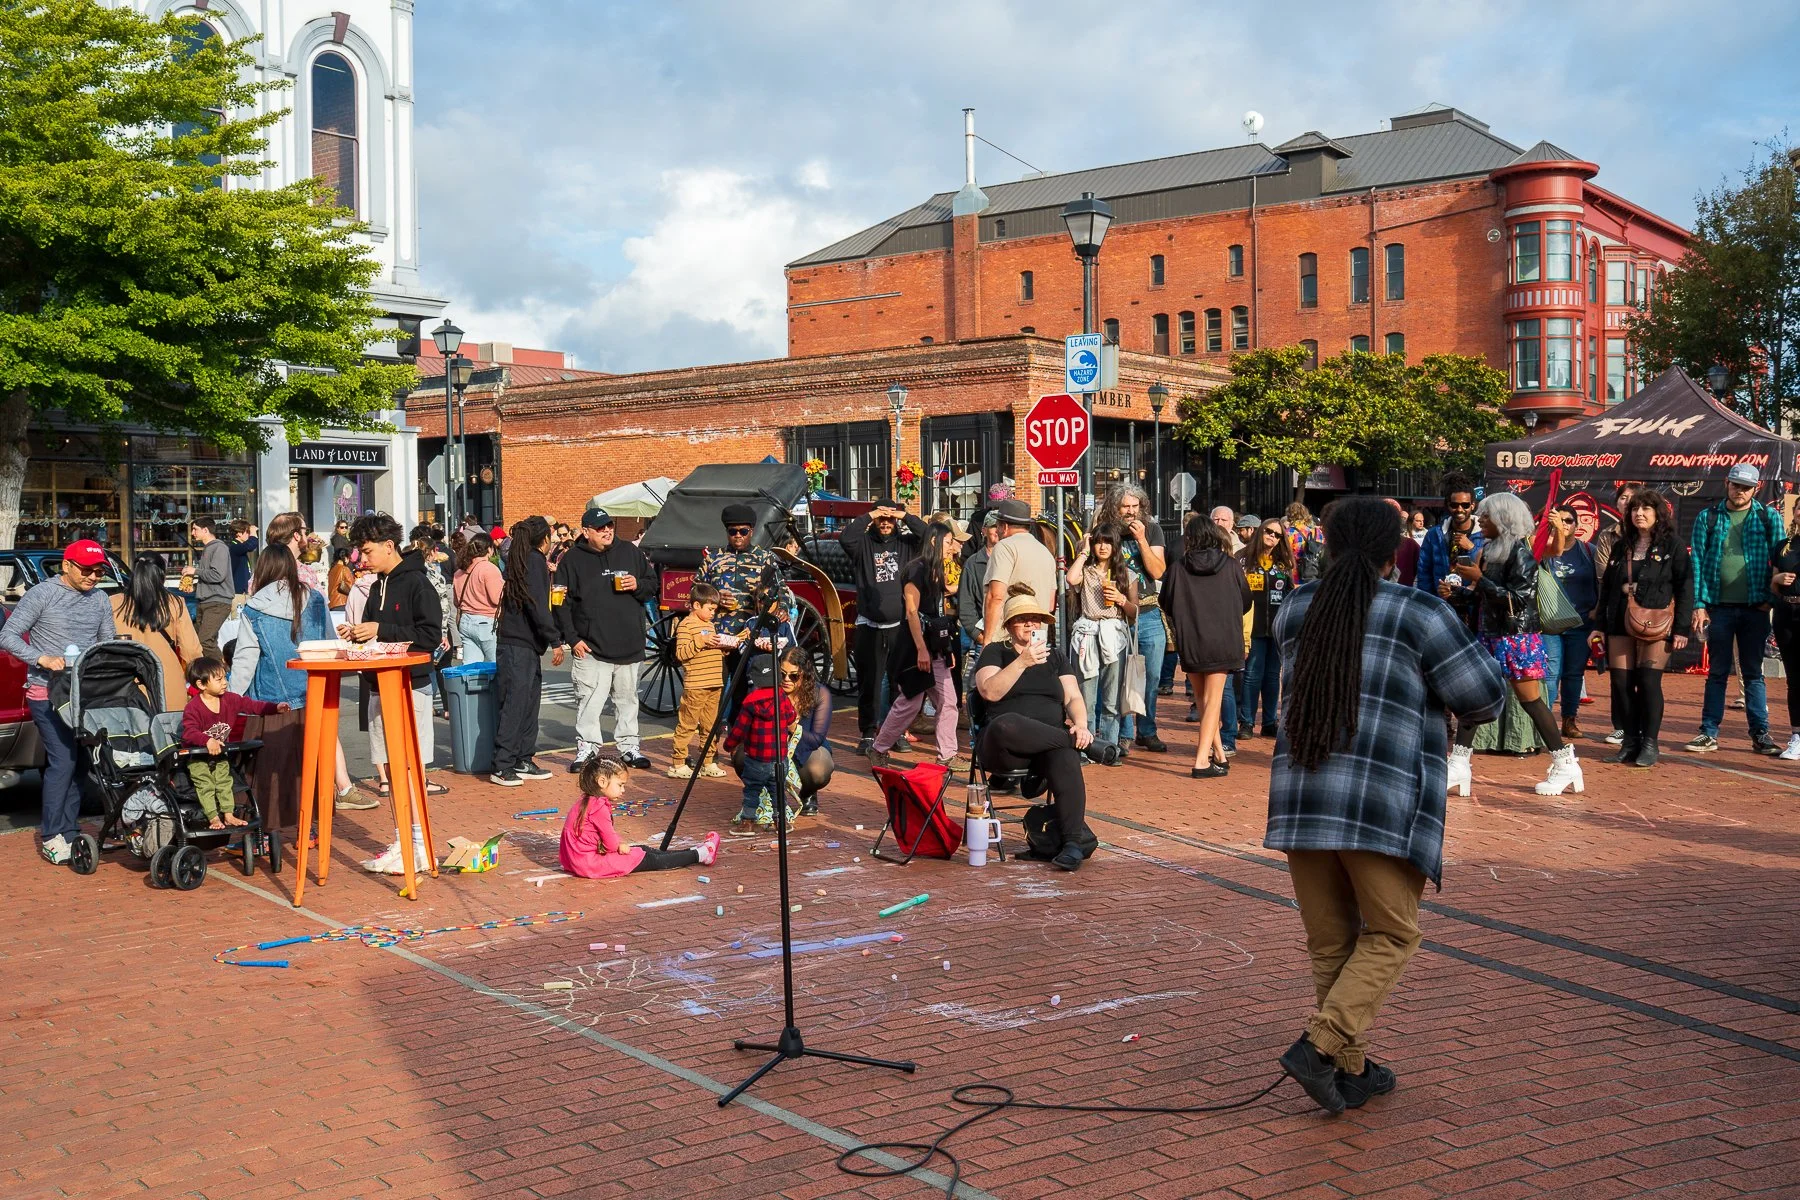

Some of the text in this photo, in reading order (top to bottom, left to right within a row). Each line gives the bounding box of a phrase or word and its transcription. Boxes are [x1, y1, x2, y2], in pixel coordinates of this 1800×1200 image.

[1070, 337, 1098, 347] LEAVING
[1092, 391, 1131, 408] IMBER
[1029, 417, 1085, 448] STOP
[295, 448, 378, 463] LAND of LOVELY
[1533, 453, 1623, 469] FOOD WITH HOY
[1040, 473, 1076, 483] ALL WAY
